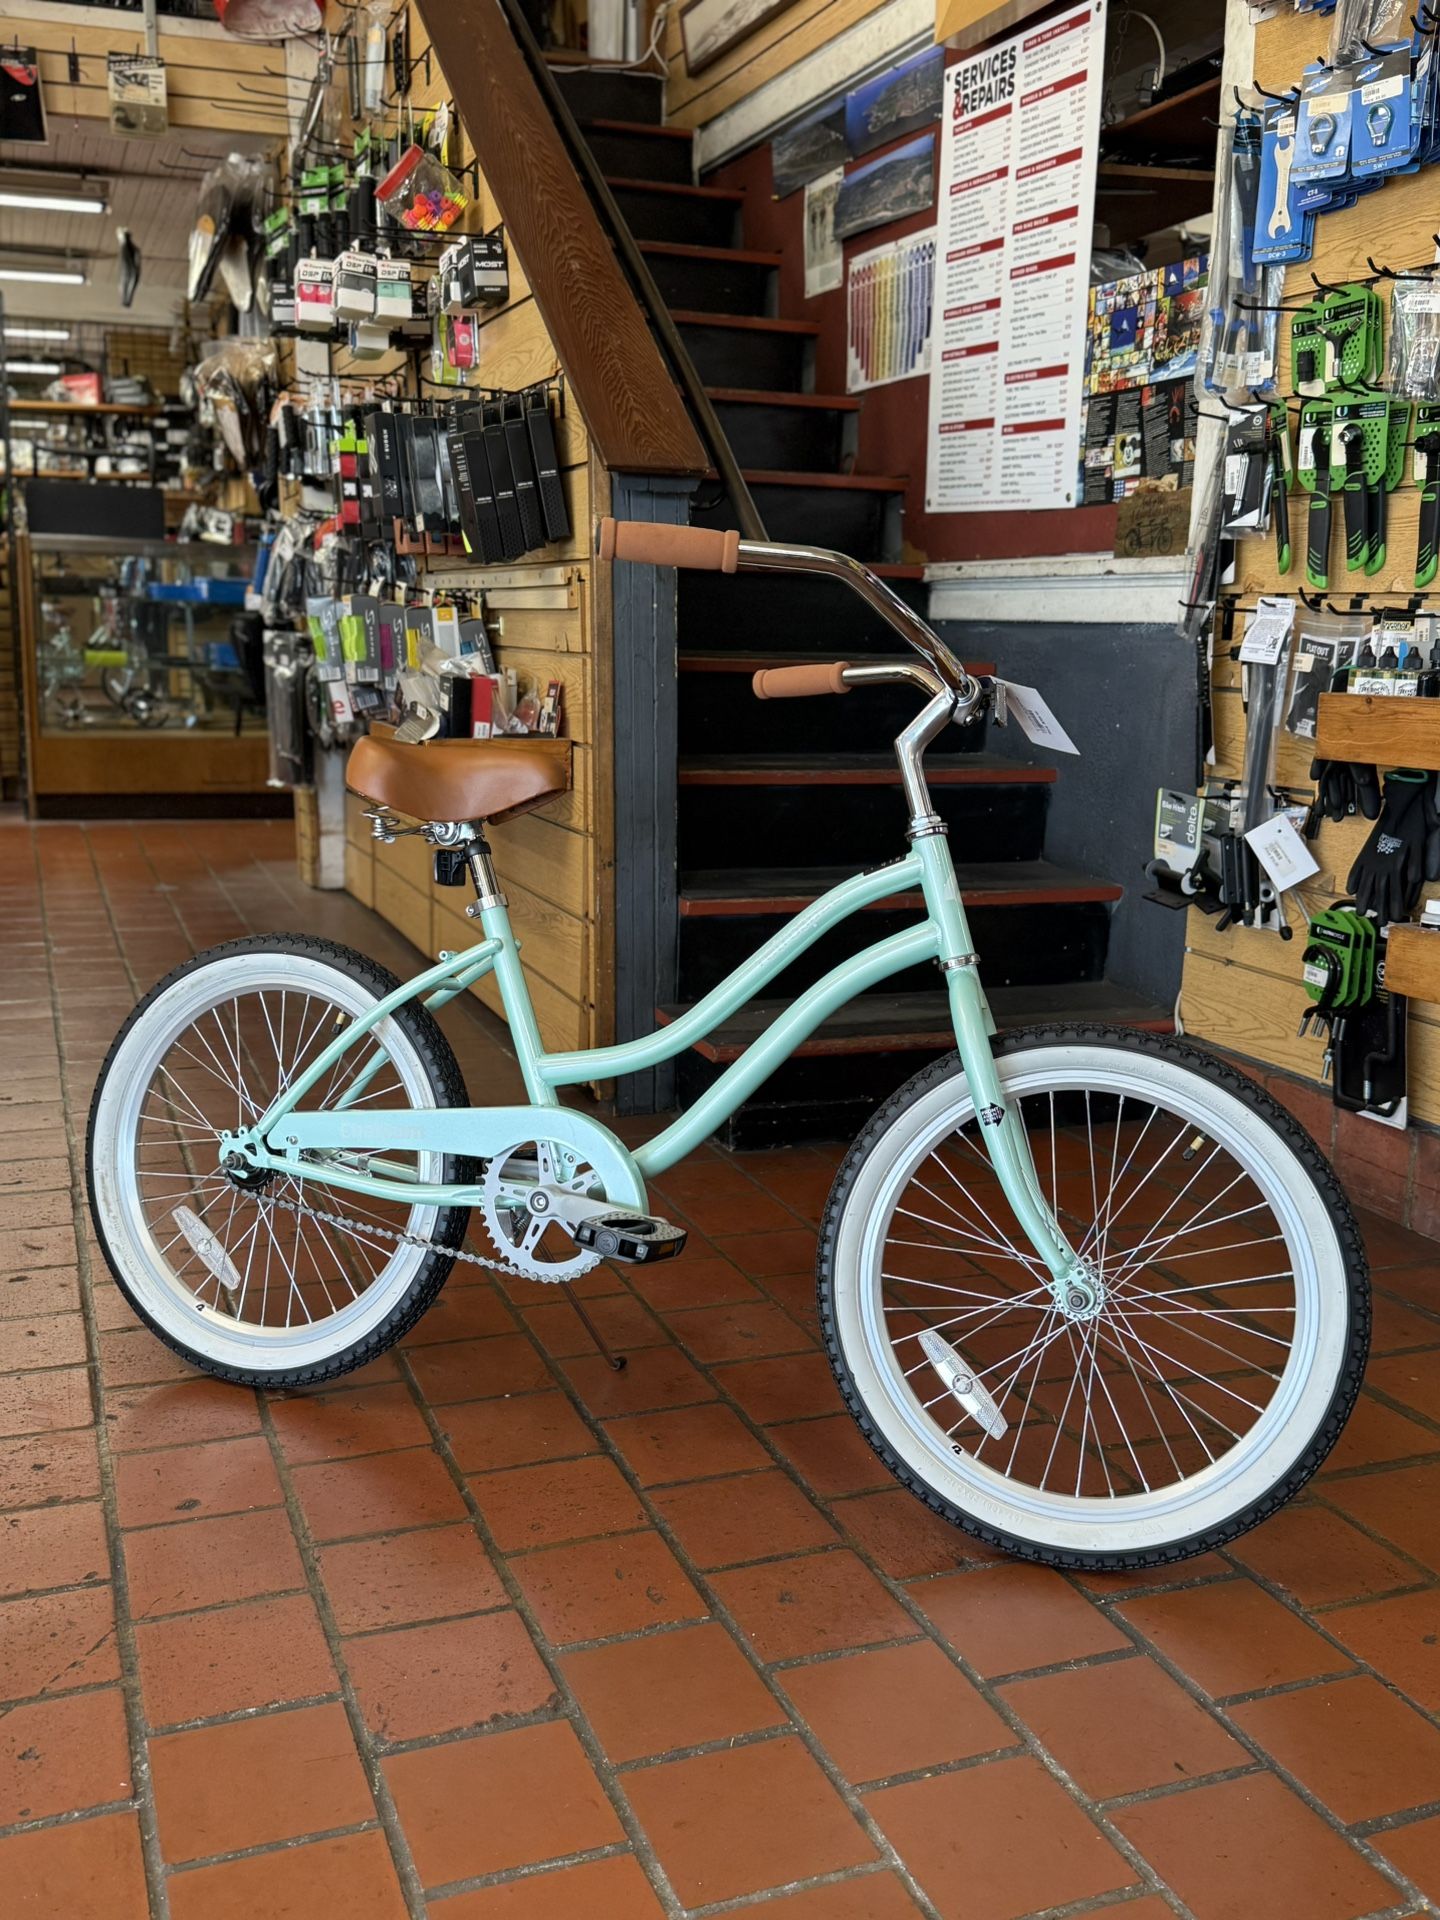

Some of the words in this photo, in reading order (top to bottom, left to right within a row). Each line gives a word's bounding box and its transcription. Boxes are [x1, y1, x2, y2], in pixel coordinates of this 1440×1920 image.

[954, 45, 1016, 94] SERVICES
[962, 72, 1015, 114] REPAIRS
[475, 260, 505, 268] MOST
